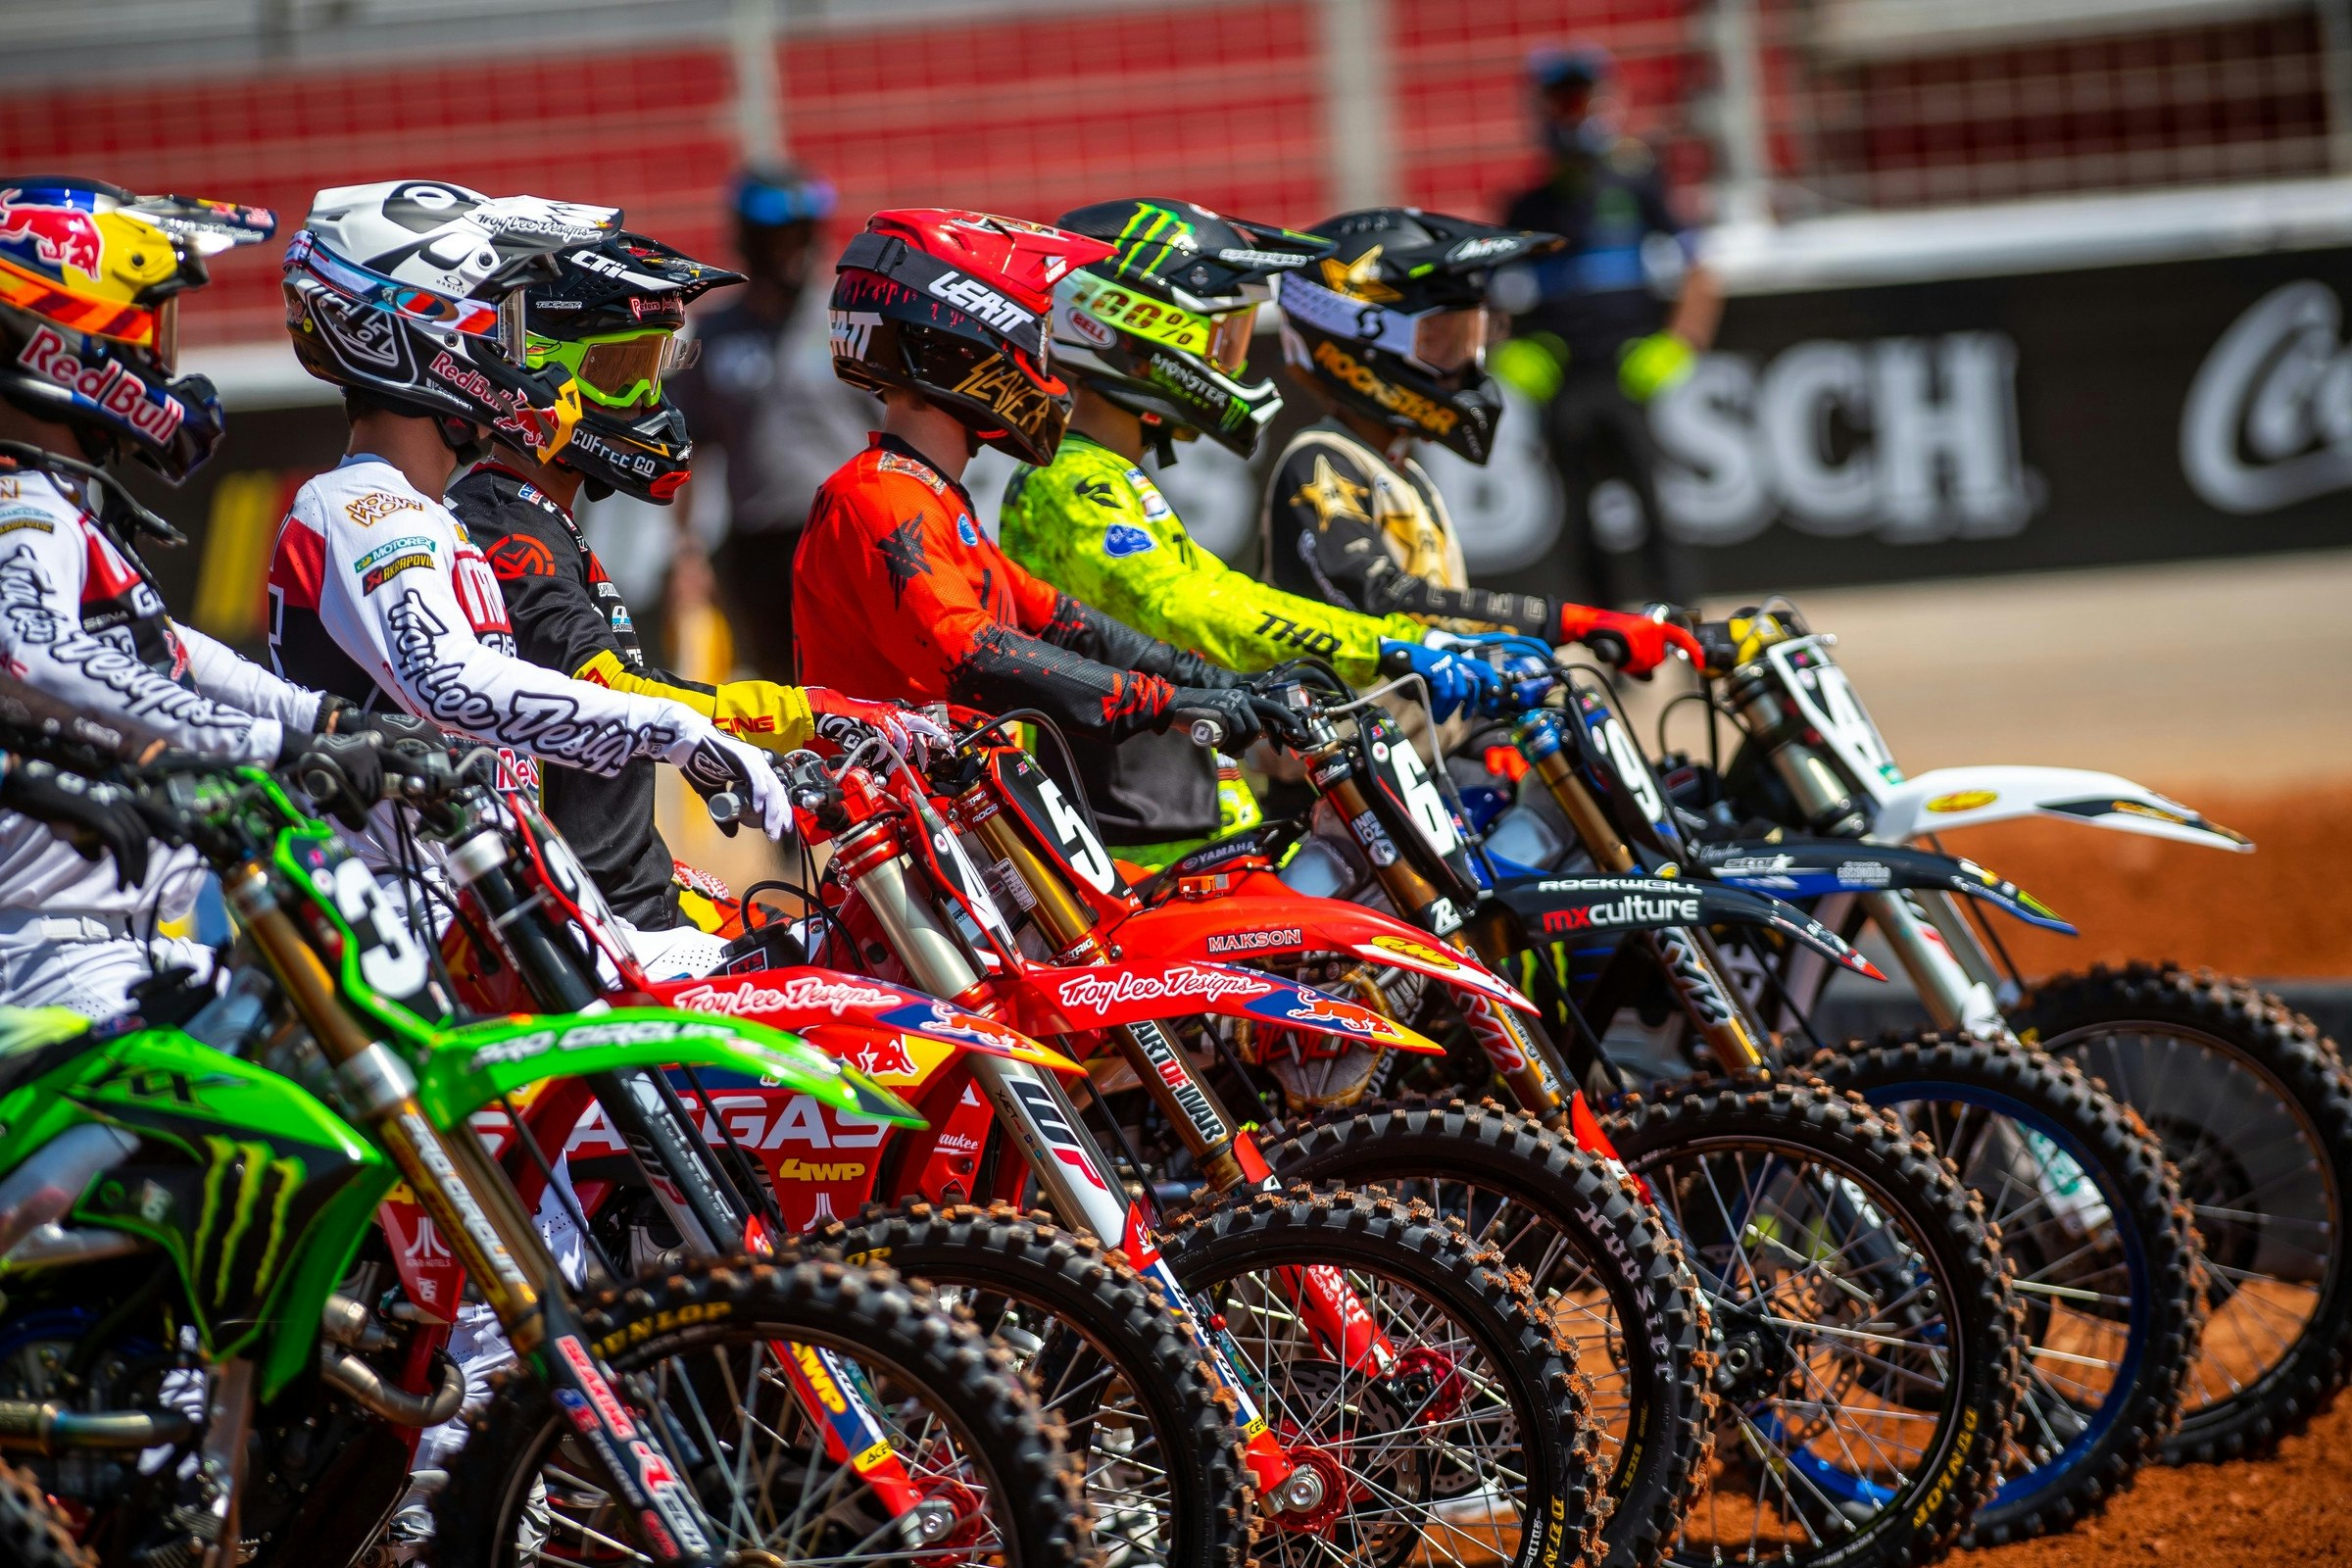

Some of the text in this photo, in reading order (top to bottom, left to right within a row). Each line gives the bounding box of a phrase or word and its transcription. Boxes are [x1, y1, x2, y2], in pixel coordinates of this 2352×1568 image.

[477, 213, 603, 241] Troy Lee Designs
[436, 278, 466, 295] OAKLEY
[628, 296, 661, 322] Peters
[1071, 280, 1201, 346] 100%
[1071, 312, 1107, 341] BELL
[18, 324, 186, 446] Red Bull
[428, 350, 479, 390] Red
[1150, 353, 1229, 409] MONSTER
[1314, 340, 1458, 436] ROCKSTAR
[951, 352, 1051, 434] SLAYER
[632, 452, 657, 478] CO
[372, 536, 433, 561] MOTOREX
[960, 790, 987, 809] XTRIG
[972, 803, 999, 823] ROCS
[1390, 738, 1457, 858] 6
[1037, 778, 1116, 895] 5
[1199, 840, 1255, 863] YAMAHA
[1538, 877, 1703, 896] ROCKWELL
[333, 857, 428, 1001] 3
[1207, 928, 1302, 954] MAKSON
[1058, 937, 1096, 964] XTRIG
[674, 976, 903, 1015] Troy Lee Designs
[1058, 966, 1272, 1015] Troy Lee Designs
[470, 1020, 739, 1070] PRO CIRCUIT
[1157, 1058, 1192, 1089] OF
[996, 1089, 1019, 1119] XACT
[1172, 1084, 1228, 1145] WAR
[1620, 1443, 1642, 1491] EXCEL
[1913, 1404, 1979, 1530] DUNLOP
